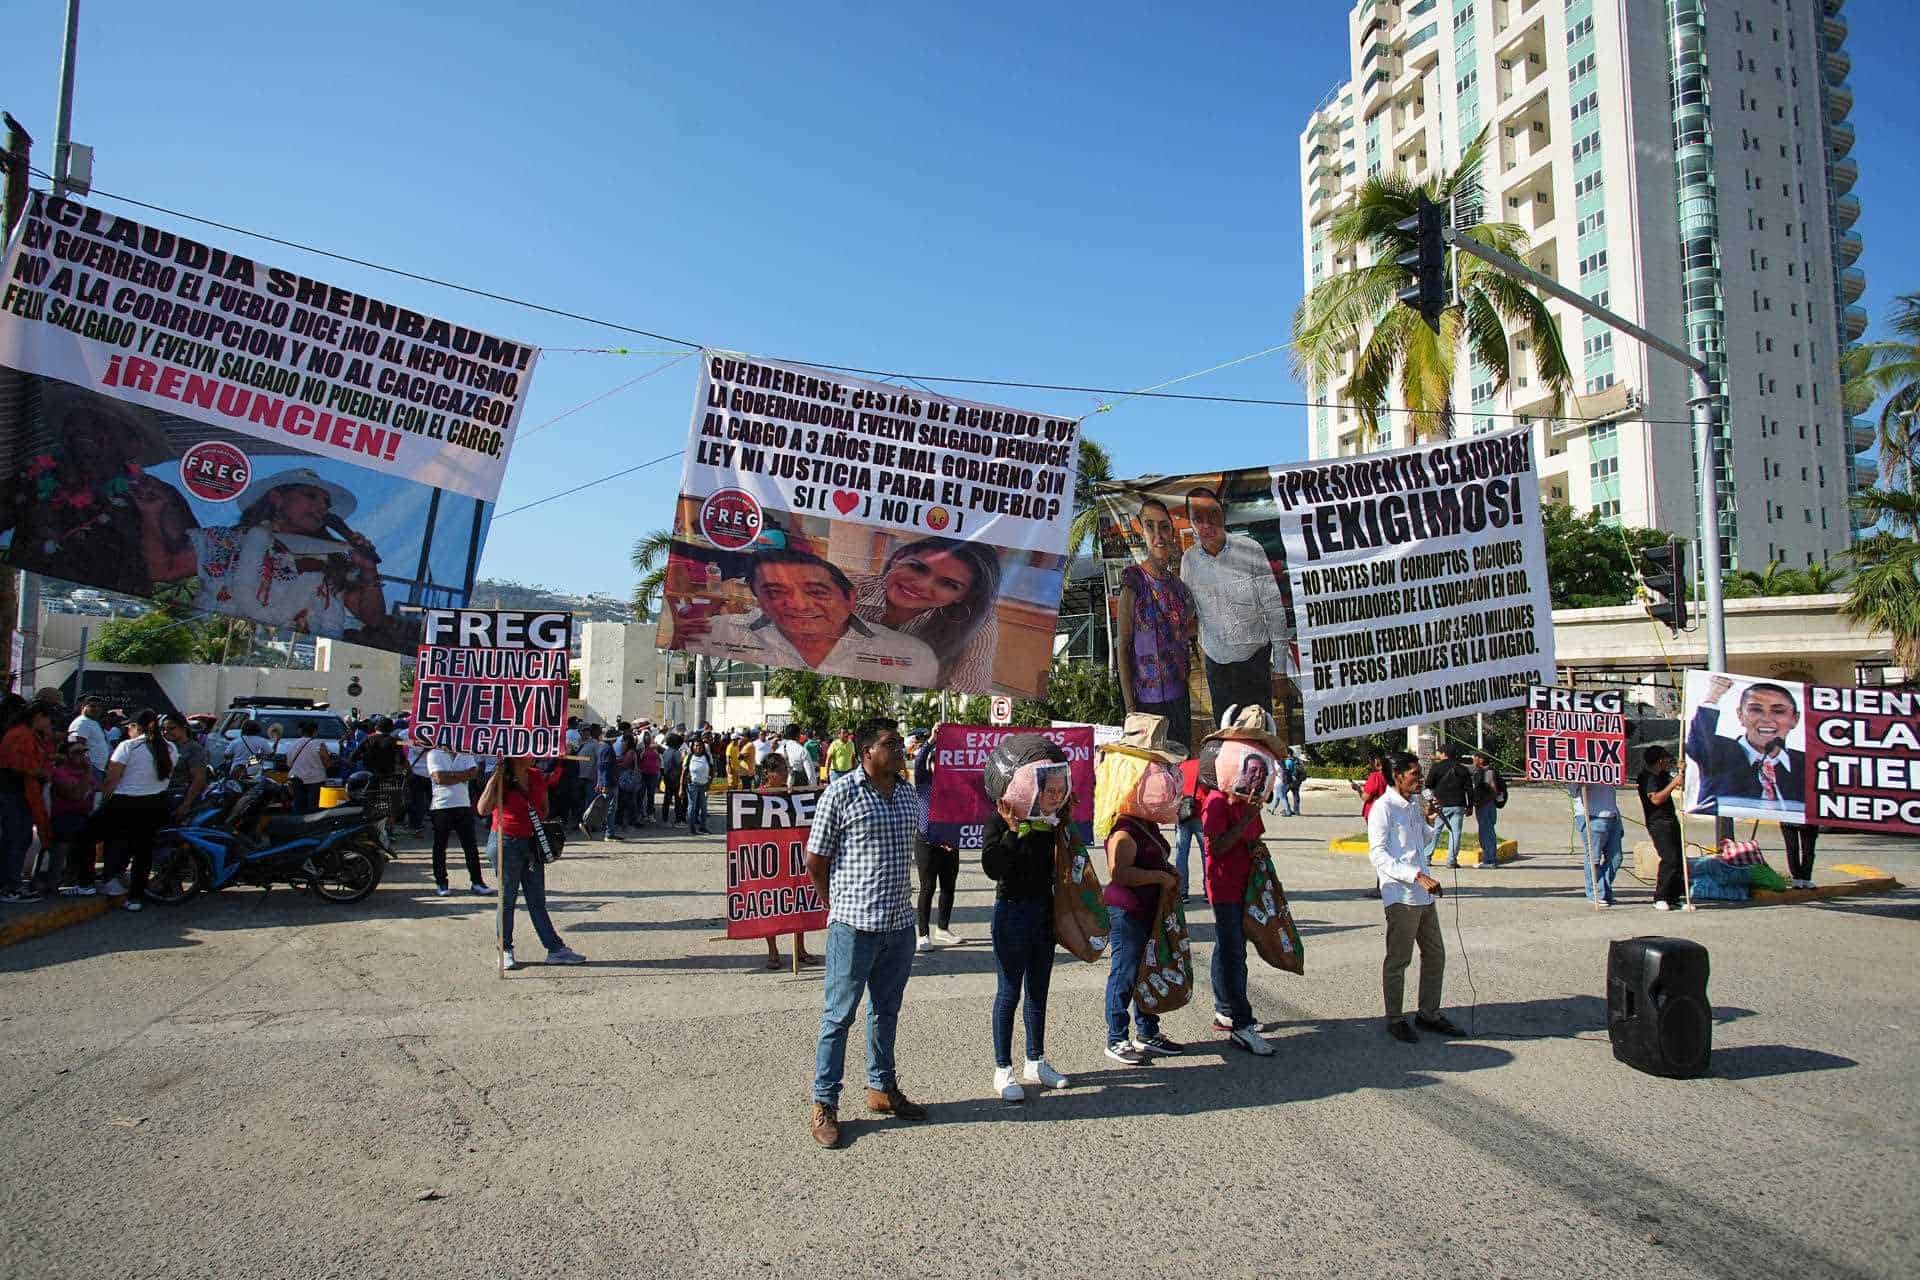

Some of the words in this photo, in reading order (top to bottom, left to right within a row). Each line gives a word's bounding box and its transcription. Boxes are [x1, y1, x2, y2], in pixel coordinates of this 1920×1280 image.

[21, 219, 51, 250] EN
[52, 230, 177, 292] GUERRERO
[176, 272, 204, 302] EL
[204, 280, 289, 328] PUEBLO
[289, 307, 342, 344] DICE
[340, 325, 380, 355] ¡NO
[378, 335, 405, 365] AL
[405, 342, 519, 401] NEPOTISMO,
[266, 267, 533, 371] SHEINBAUM!
[12, 252, 50, 286] NO
[49, 267, 73, 297] A
[75, 272, 111, 307] LA
[112, 287, 288, 361] CORRUPCION
[290, 341, 310, 367] Y
[306, 345, 345, 378] NO
[343, 358, 373, 388] AL
[376, 367, 514, 429] CACICAZGO!
[46, 297, 137, 347] SALGADO
[138, 328, 154, 352] Y
[150, 330, 220, 373] EVELYN
[218, 351, 301, 398] SALGADO
[301, 376, 328, 405] NO
[326, 384, 393, 424] PUEDEN
[391, 403, 433, 435] CON
[427, 413, 448, 441] EL
[102, 354, 402, 462] ¡RENUNCIEN!
[707, 383, 728, 409] LA
[730, 387, 855, 431] GOBERNADORA
[857, 413, 916, 442] EVELYN
[917, 423, 993, 457] SALGADO
[995, 437, 1071, 467] RENUNCIE
[927, 402, 950, 422] DE
[954, 406, 1040, 437] ACUERDO
[1044, 420, 1076, 442] QUE
[186, 455, 246, 482] FREG
[701, 412, 723, 438] AL
[726, 416, 788, 449] CARGO
[788, 428, 803, 450] A
[805, 430, 819, 453] 3
[820, 431, 872, 463] AÑOS
[872, 442, 896, 467] DE
[898, 447, 936, 474] MAL
[942, 454, 1033, 490] GOBIERNO
[1036, 469, 1066, 496] SIN
[1277, 452, 1426, 512] ¡PRESIDENTA
[1428, 433, 1531, 487] CLAUDIA!
[696, 439, 736, 468] LEY
[739, 447, 765, 473] NI
[769, 452, 872, 491] JUSTICIA
[877, 470, 935, 502] PARA
[941, 481, 963, 507] EL
[968, 485, 1061, 521] PUEBLO?
[793, 485, 815, 509] SI
[879, 500, 908, 525] NO
[706, 506, 759, 528] FREG
[1300, 477, 1523, 561] ¡EXIGIMOS!
[1322, 564, 1369, 593] PACTES
[1371, 559, 1396, 586] CON
[1400, 549, 1469, 582] CORRUPTOS
[1472, 540, 1523, 570] CACIQUES
[1306, 588, 1400, 628] PRIVATIZADORES
[1402, 587, 1417, 613] DE
[1418, 585, 1433, 611] LA
[1432, 572, 1490, 609] EDUCACIÓN
[1492, 573, 1505, 598] EN
[1507, 570, 1531, 596] GRO.
[425, 610, 566, 649] FREG
[1375, 623, 1424, 654] FEDERAL
[1425, 622, 1433, 645] A
[1433, 618, 1451, 644] LOS
[1450, 612, 1484, 642] 3,500
[1484, 604, 1535, 635] MILLONES
[418, 647, 568, 681] ¡RENUNCIA
[1313, 664, 1333, 691] DE
[1339, 656, 1388, 687] PESOS
[1390, 645, 1448, 679] ANUALES
[1451, 641, 1468, 667] EN
[1471, 638, 1487, 664] LA
[1488, 630, 1540, 661] UAGRO.
[416, 681, 564, 727] EVELYN
[1314, 700, 1357, 736] ¿QUIÉN
[1359, 700, 1372, 725] ES
[1374, 698, 1385, 723] EL
[1387, 688, 1423, 720] DUEÑO
[1423, 687, 1444, 713] DEL
[1445, 678, 1488, 709] COLEGIO
[1528, 710, 1622, 734] ¡RENUNCIA
[1530, 685, 1621, 713] FREG
[1812, 687, 1920, 716] BIEN
[414, 725, 561, 757] SALGADO!
[1530, 761, 1621, 784] SALGADO!
[728, 841, 780, 888] ¡NO
[728, 886, 824, 922] CACICAZ
